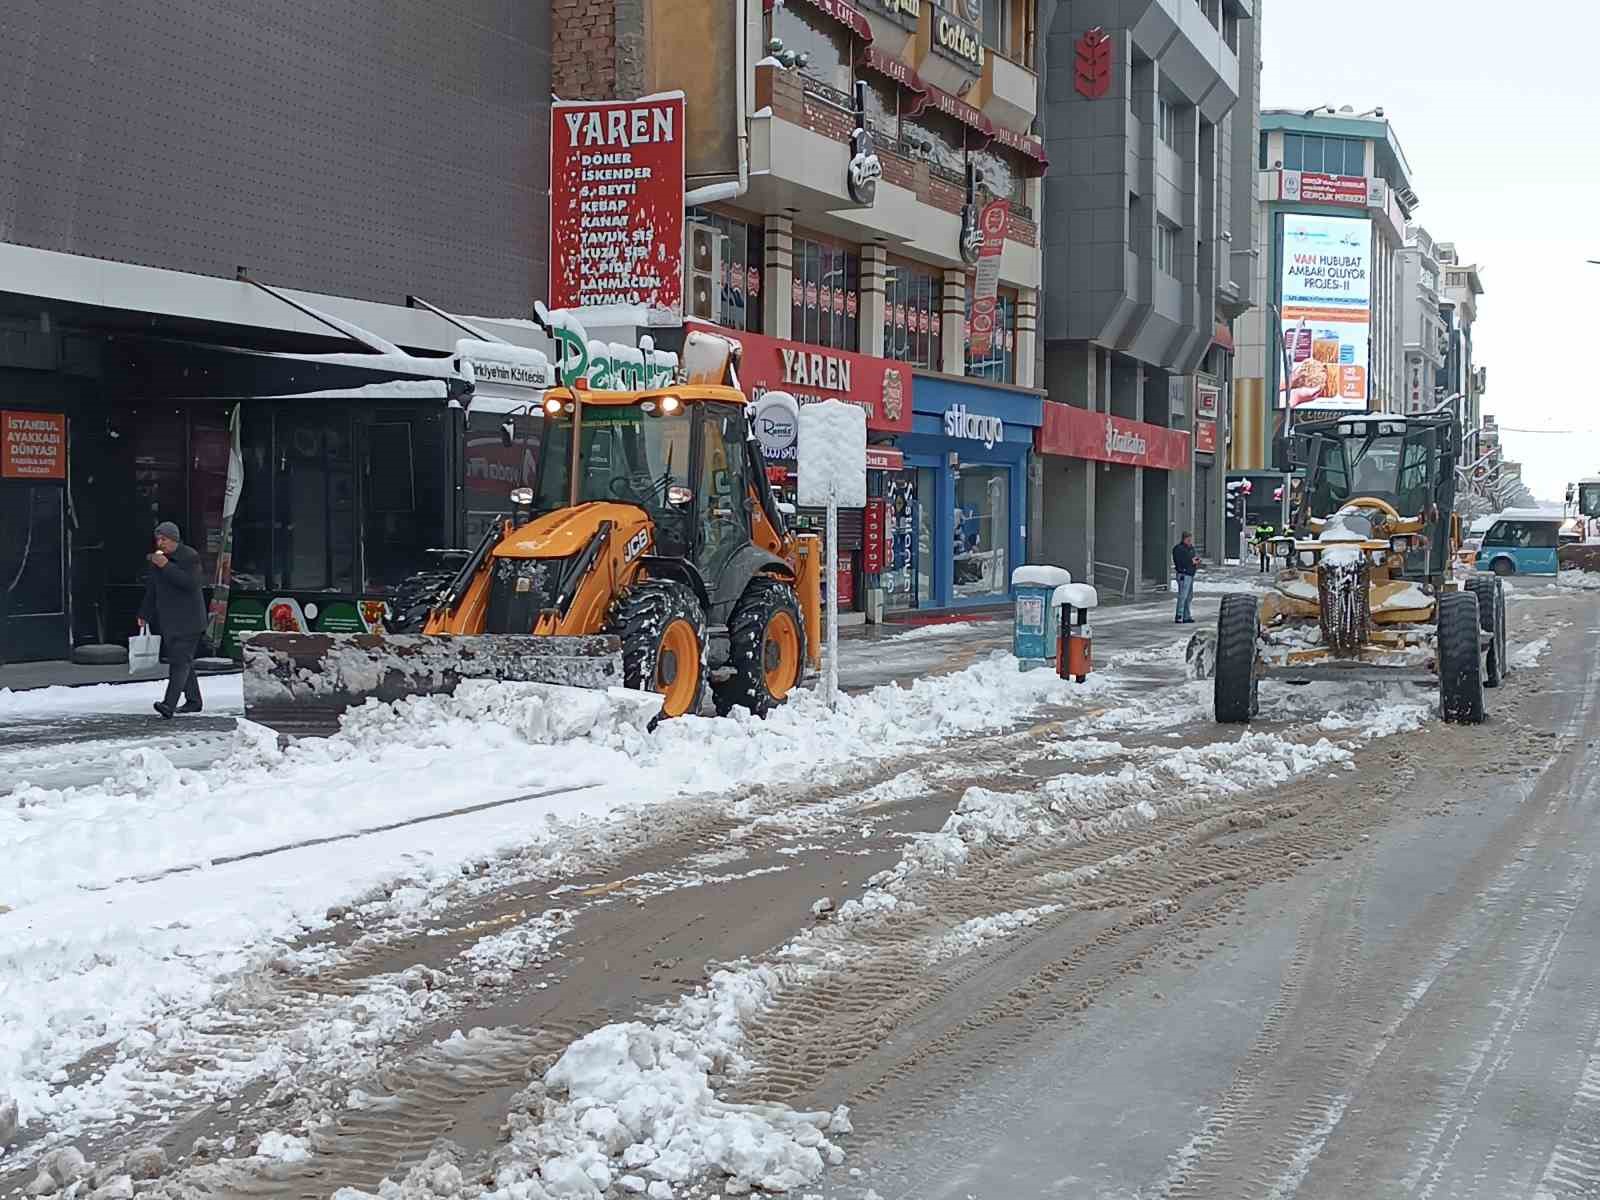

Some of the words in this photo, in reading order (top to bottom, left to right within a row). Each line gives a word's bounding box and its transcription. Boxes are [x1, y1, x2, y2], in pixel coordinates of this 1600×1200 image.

[564, 106, 674, 148] YAREN
[581, 151, 632, 165] DÖNER
[581, 166, 652, 181] İSKENDER
[581, 200, 628, 213] KEBAP
[1294, 253, 1317, 265] VAN
[1327, 268, 1366, 280] OLUYOR
[581, 277, 660, 290] LAHMACUN
[782, 348, 851, 392] YAREN
[8, 432, 60, 444] AYAKKABI
[11, 443, 57, 456] DÜNYASI
[623, 527, 648, 563] JCB
